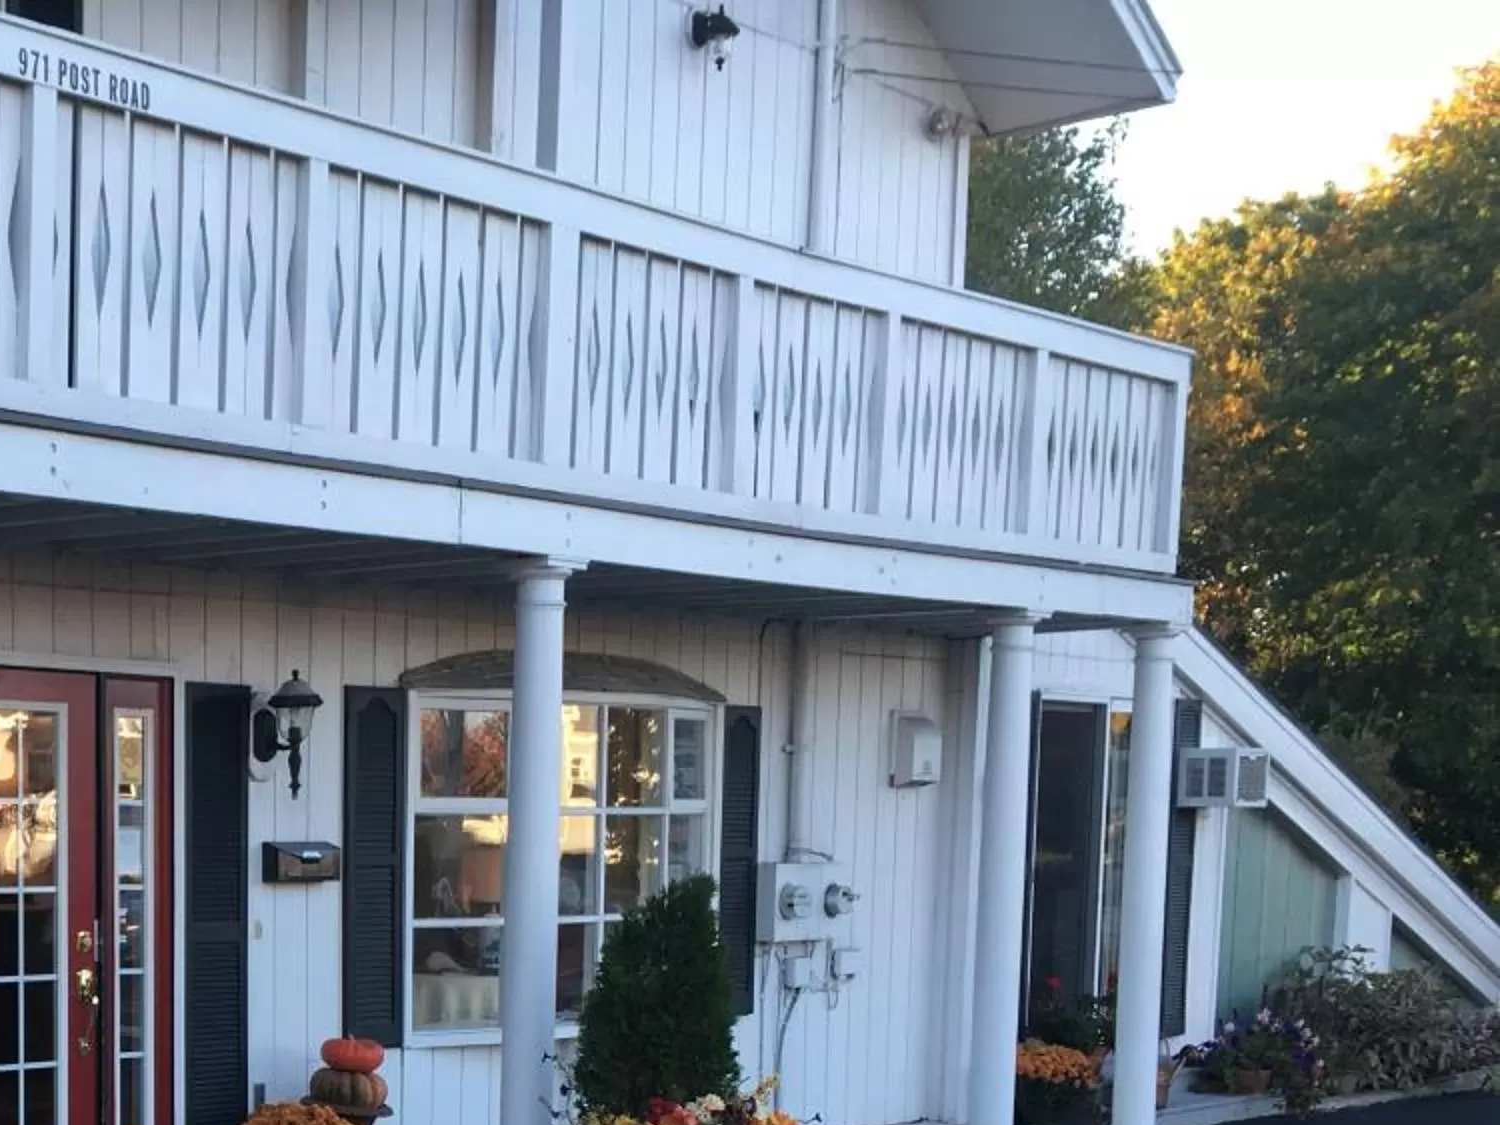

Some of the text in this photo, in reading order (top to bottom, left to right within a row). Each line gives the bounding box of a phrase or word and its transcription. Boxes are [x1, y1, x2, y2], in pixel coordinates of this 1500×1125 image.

[18, 47, 150, 111] 971 POST ROAD
